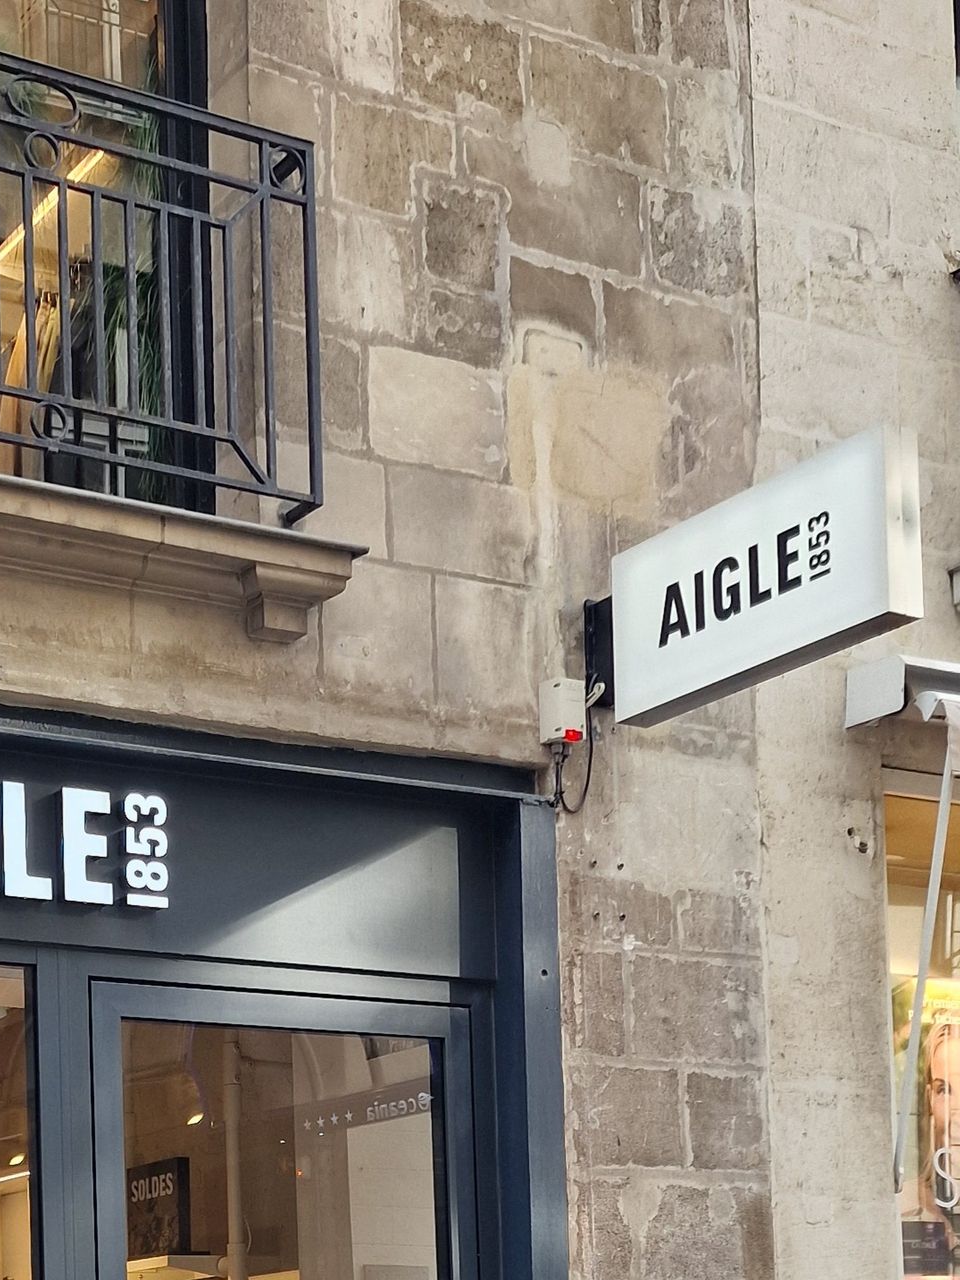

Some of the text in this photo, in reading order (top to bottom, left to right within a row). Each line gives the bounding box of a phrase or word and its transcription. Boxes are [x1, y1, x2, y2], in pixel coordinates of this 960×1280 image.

[658, 510, 831, 648] AIGLE 1853
[124, 791, 170, 909] 1853
[131, 1172, 174, 1203] SOLDES
